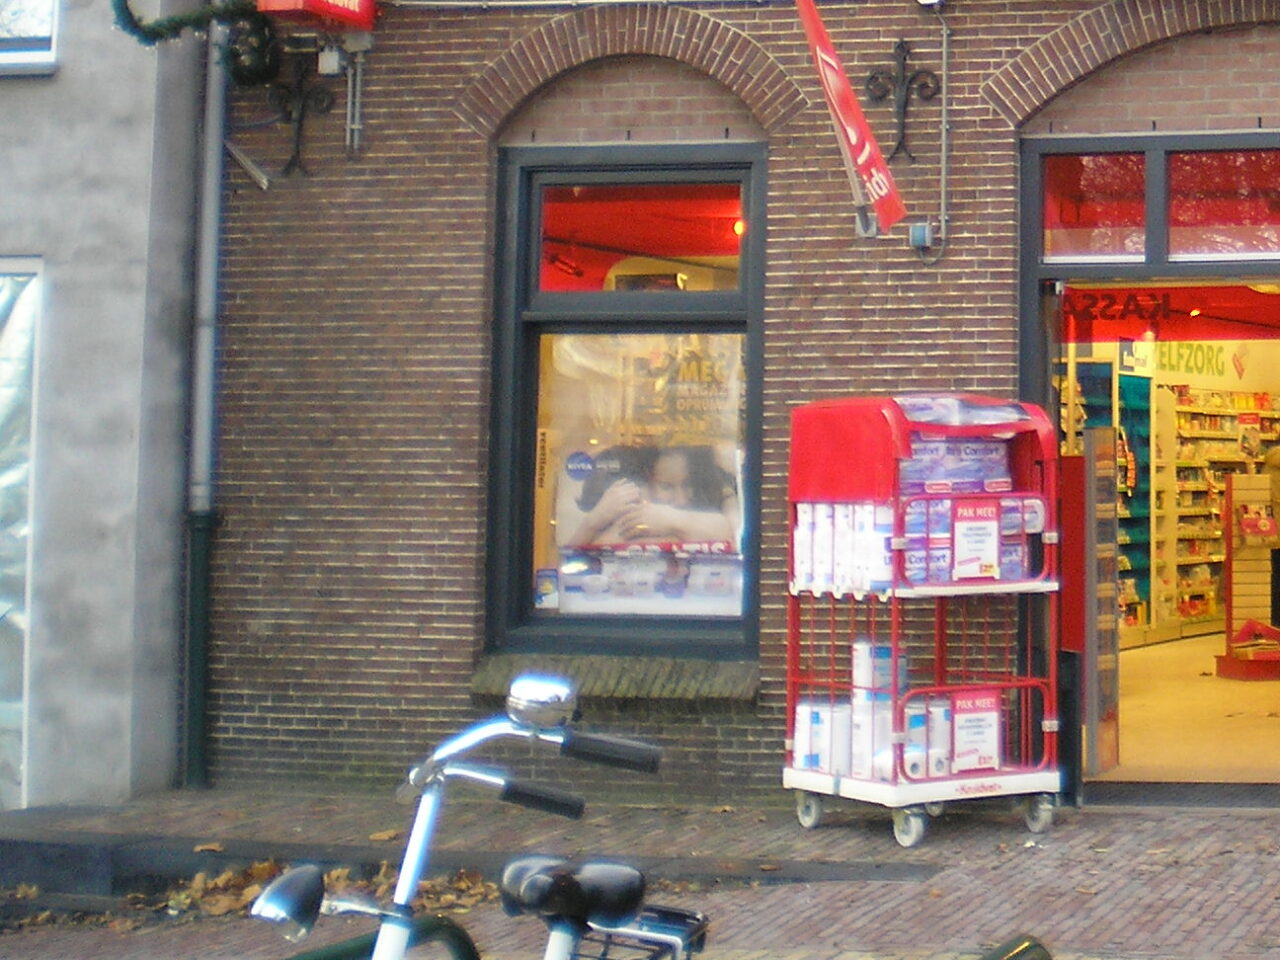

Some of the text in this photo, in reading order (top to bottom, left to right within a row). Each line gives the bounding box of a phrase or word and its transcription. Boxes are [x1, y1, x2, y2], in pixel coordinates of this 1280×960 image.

[1154, 342, 1225, 377] ELFZORG
[567, 462, 593, 470] NIVEA
[957, 508, 973, 518] PAK
